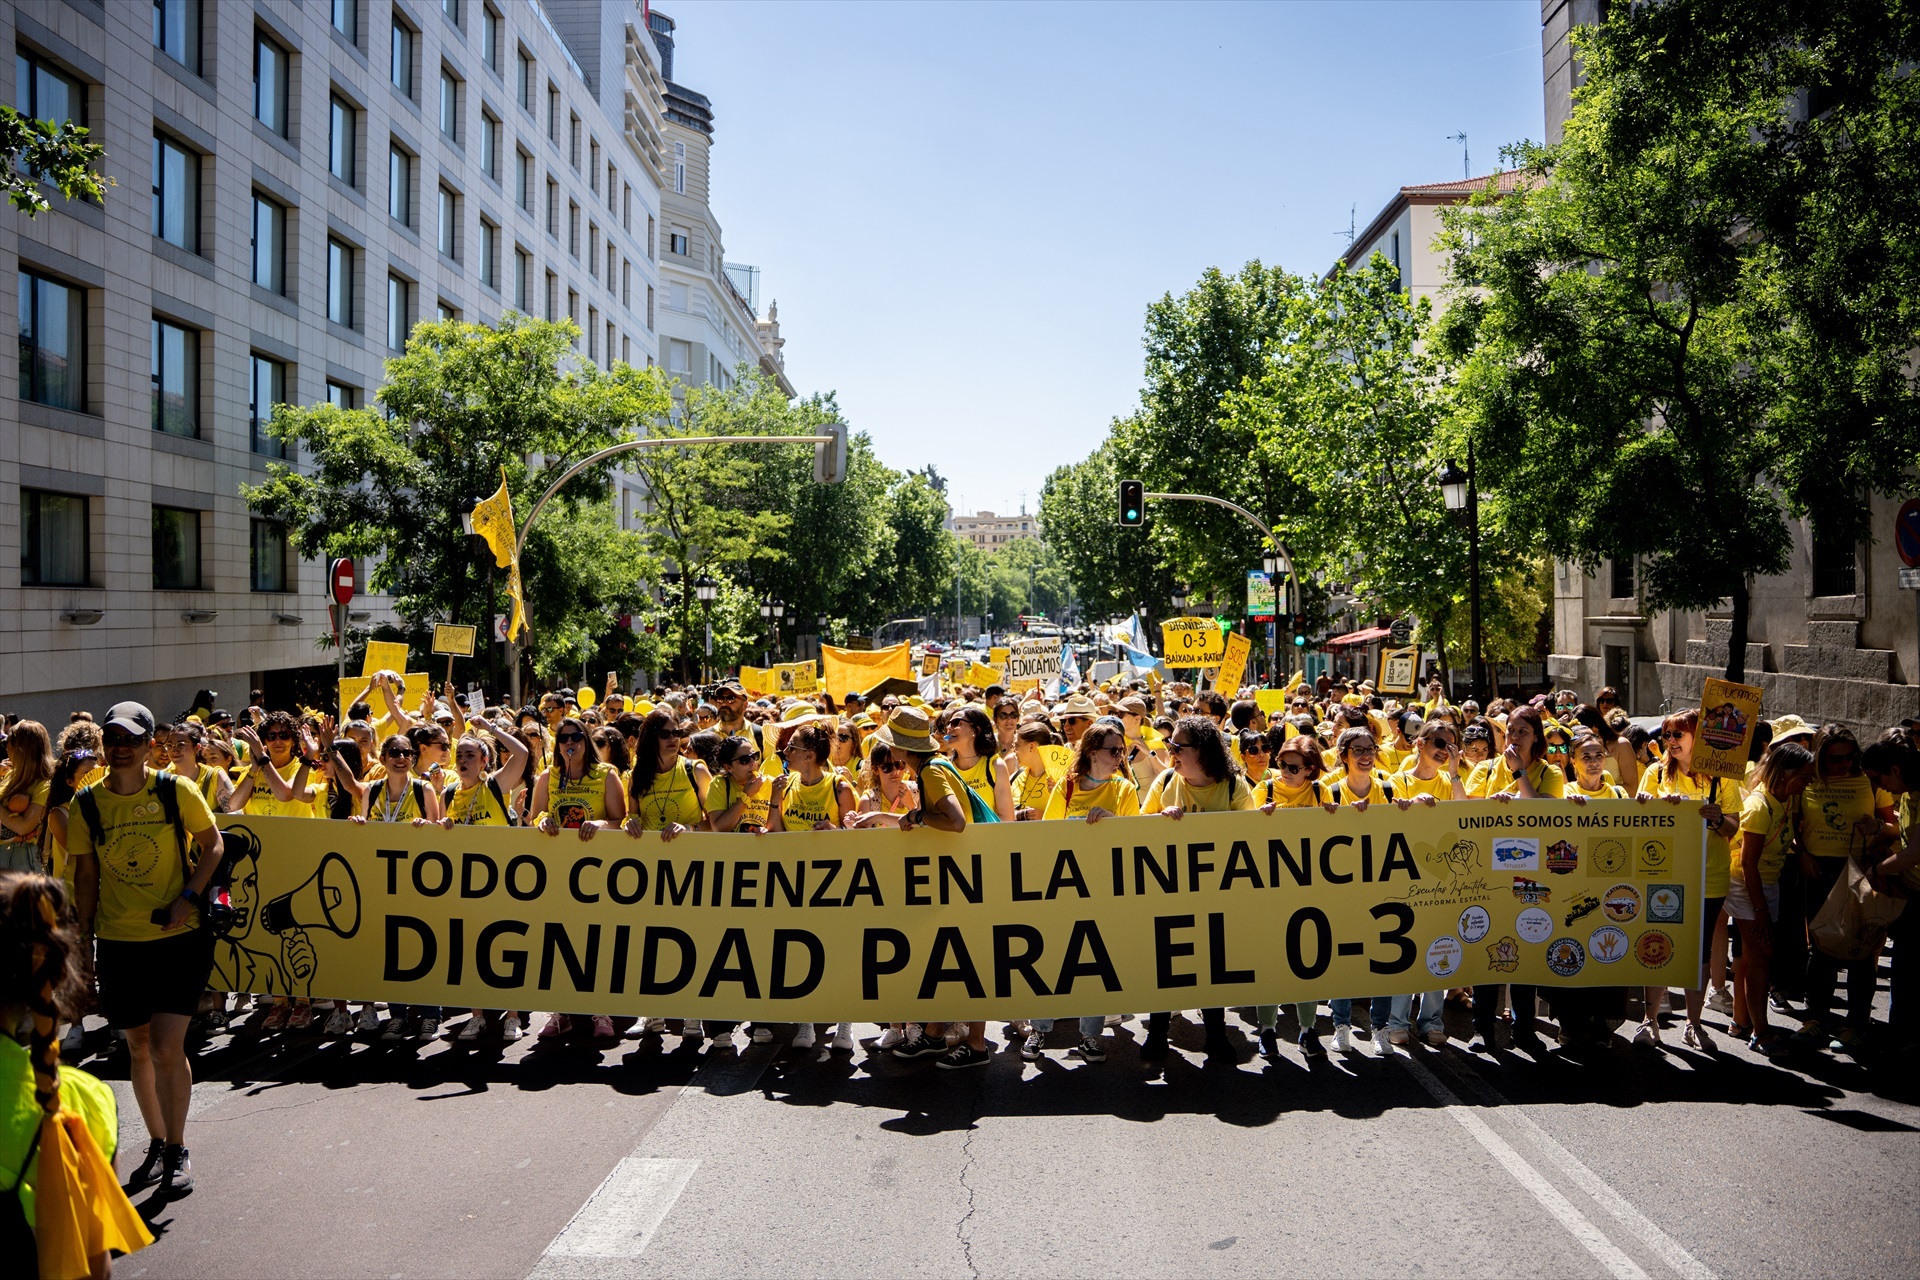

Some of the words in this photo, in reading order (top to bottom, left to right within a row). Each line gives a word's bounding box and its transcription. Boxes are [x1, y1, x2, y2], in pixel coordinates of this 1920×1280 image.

[1183, 632, 1207, 648] 0-3
[1011, 645, 1021, 655] NO
[1022, 645, 1060, 655] GUARDAMOS
[1228, 646, 1246, 667] SOS
[1012, 656, 1062, 677] EDUCAMOS
[1708, 684, 1759, 703] EDUCAMOS
[1705, 729, 1733, 738] PLATAFORMA
[1711, 750, 1727, 761] NO
[1693, 756, 1745, 774] GUARDAMOS
[784, 808, 831, 821] AMARILLA
[1458, 815, 1514, 830] UNIDAS
[1517, 815, 1573, 828] SOMOS
[1577, 811, 1609, 828] MÁS
[1613, 815, 1676, 828] FUERTES
[375, 849, 548, 902] TODO
[568, 856, 885, 908] COMIENZA
[904, 853, 984, 906] EN
[1010, 849, 1091, 902] LA
[1111, 832, 1422, 897] INFANCIA
[1459, 895, 1491, 904] ESTATAL
[382, 914, 826, 1000] DIGNIDAD
[861, 919, 1124, 1001] PARA
[1153, 912, 1256, 990] EL
[1285, 901, 1418, 981] 0-3
